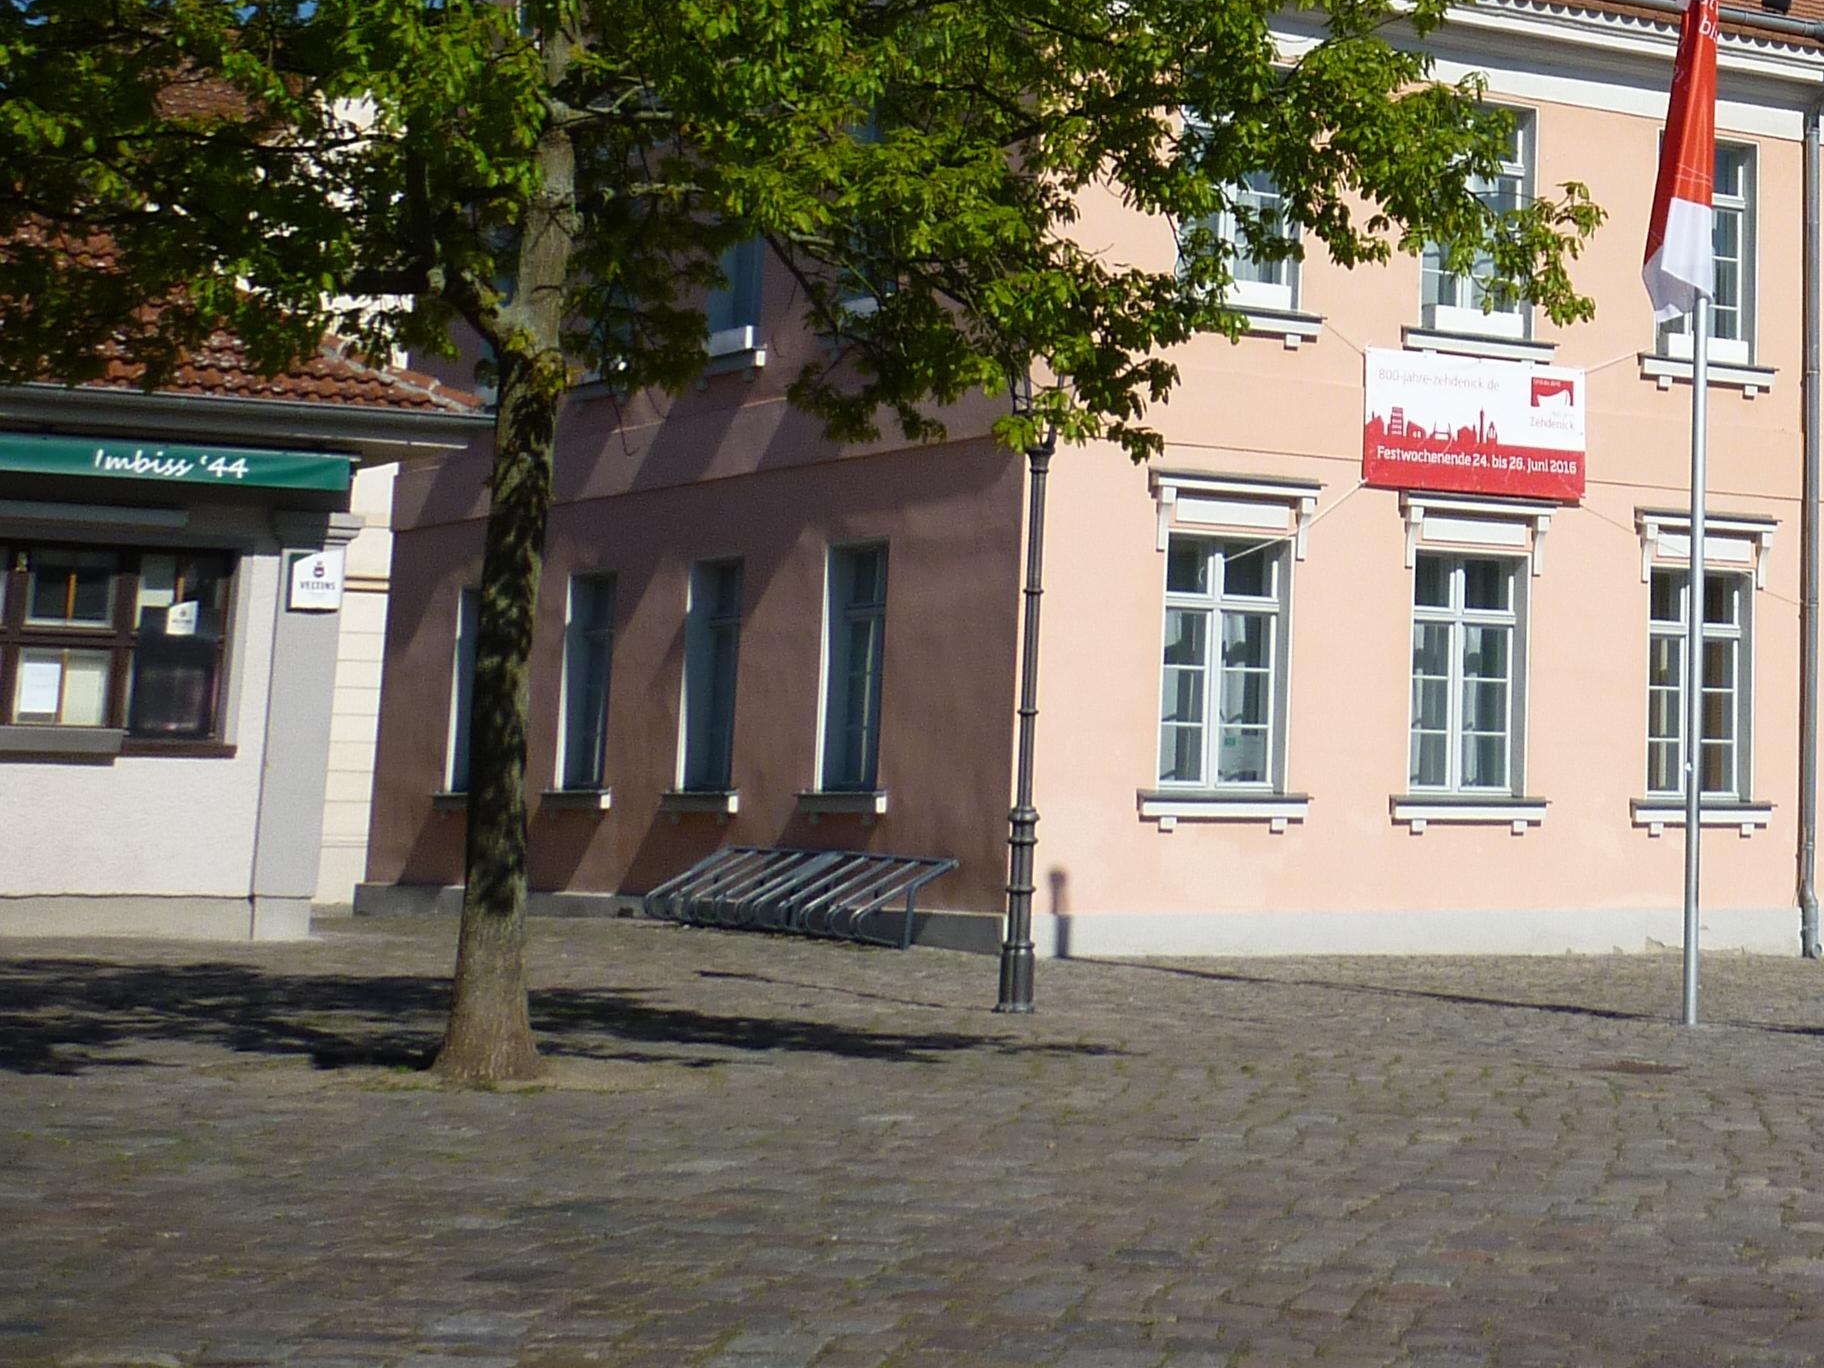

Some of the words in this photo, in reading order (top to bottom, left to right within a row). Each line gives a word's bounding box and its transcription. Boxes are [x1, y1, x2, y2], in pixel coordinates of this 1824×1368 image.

[94, 448, 195, 478] Imbiss
[1377, 445, 1471, 465] Festwochenende
[1472, 453, 1490, 467] 24.
[1491, 454, 1507, 469] bis
[1508, 456, 1526, 471] 26.
[1549, 459, 1577, 475] 2016
